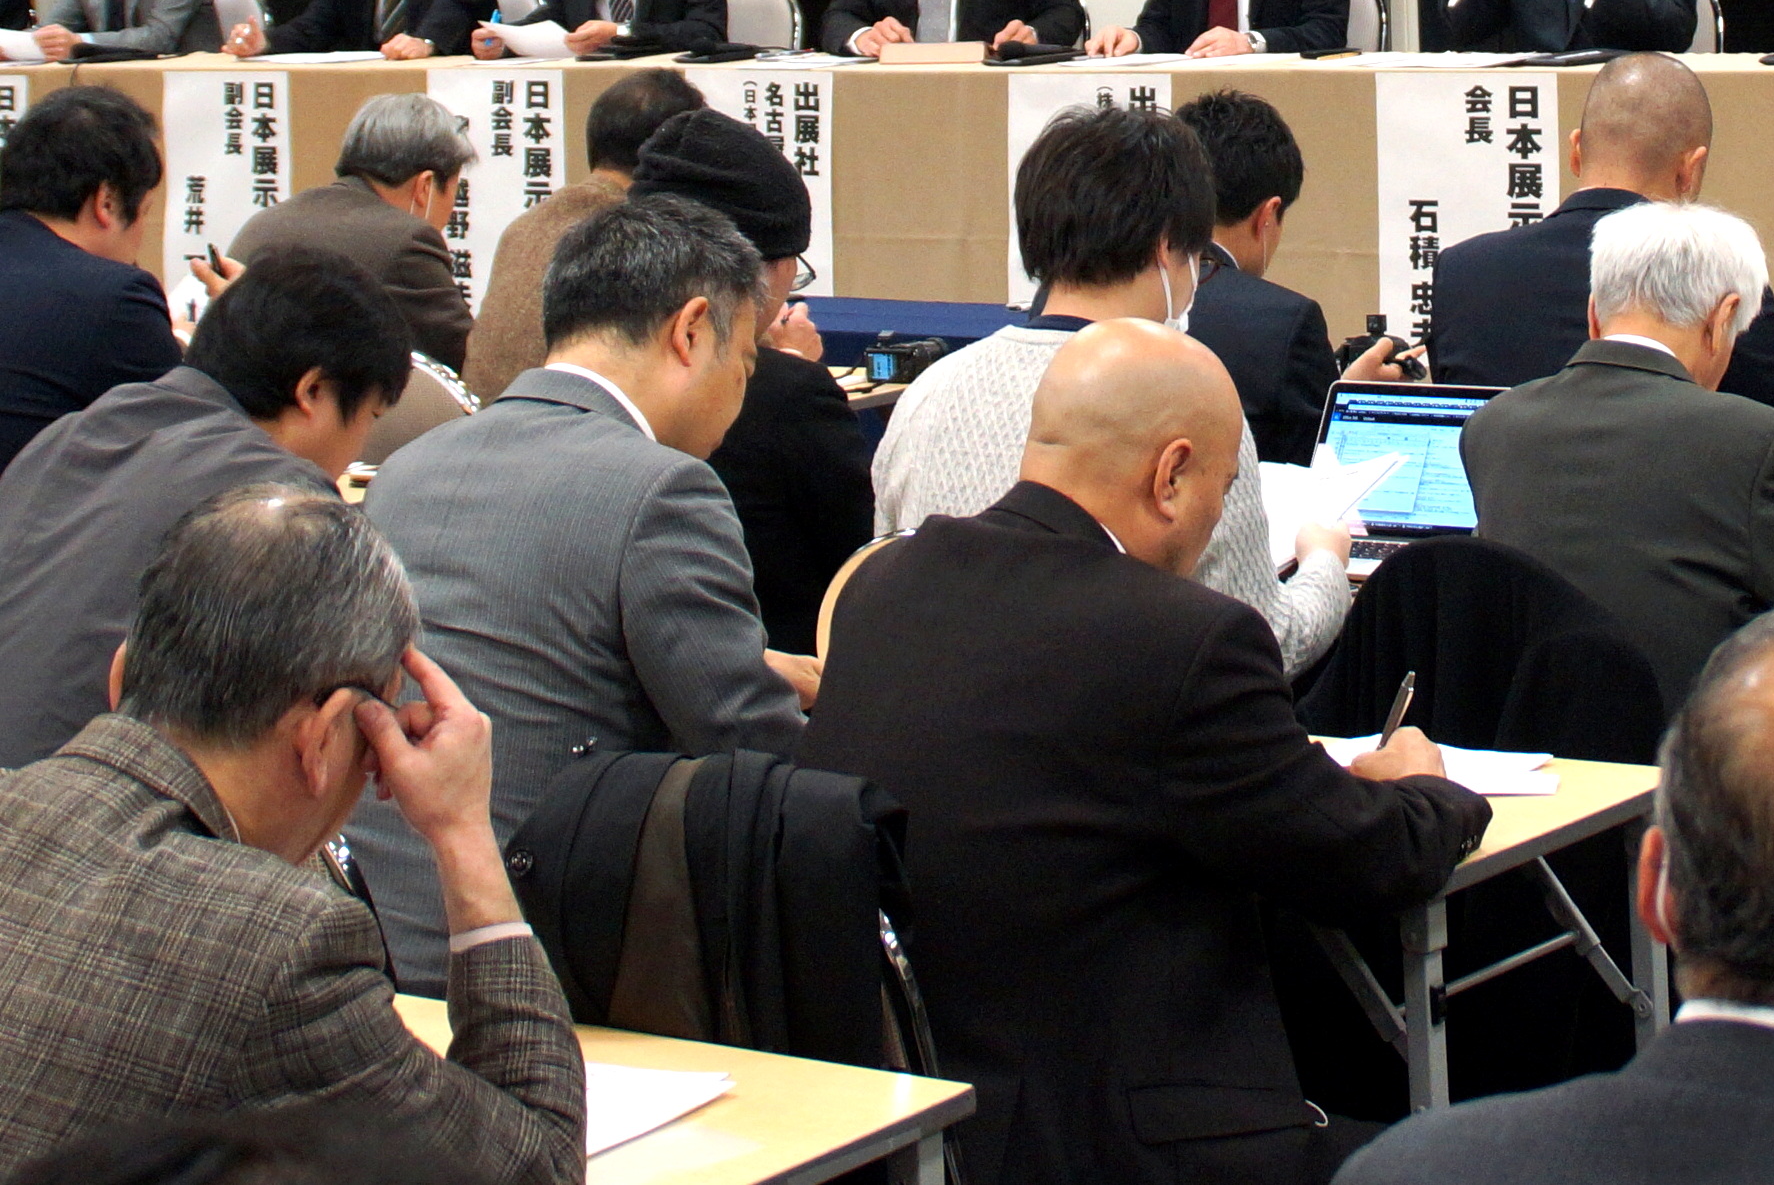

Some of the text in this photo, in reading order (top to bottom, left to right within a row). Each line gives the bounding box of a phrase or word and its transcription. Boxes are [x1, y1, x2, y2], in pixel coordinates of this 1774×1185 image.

[223, 81, 243, 155] 副会長
[491, 80, 514, 157] 副会長
[794, 82, 819, 176] 出展社
[1464, 85, 1493, 144] 会長
[184, 175, 206, 235] 荒井
[1408, 199, 1439, 270] 石積
